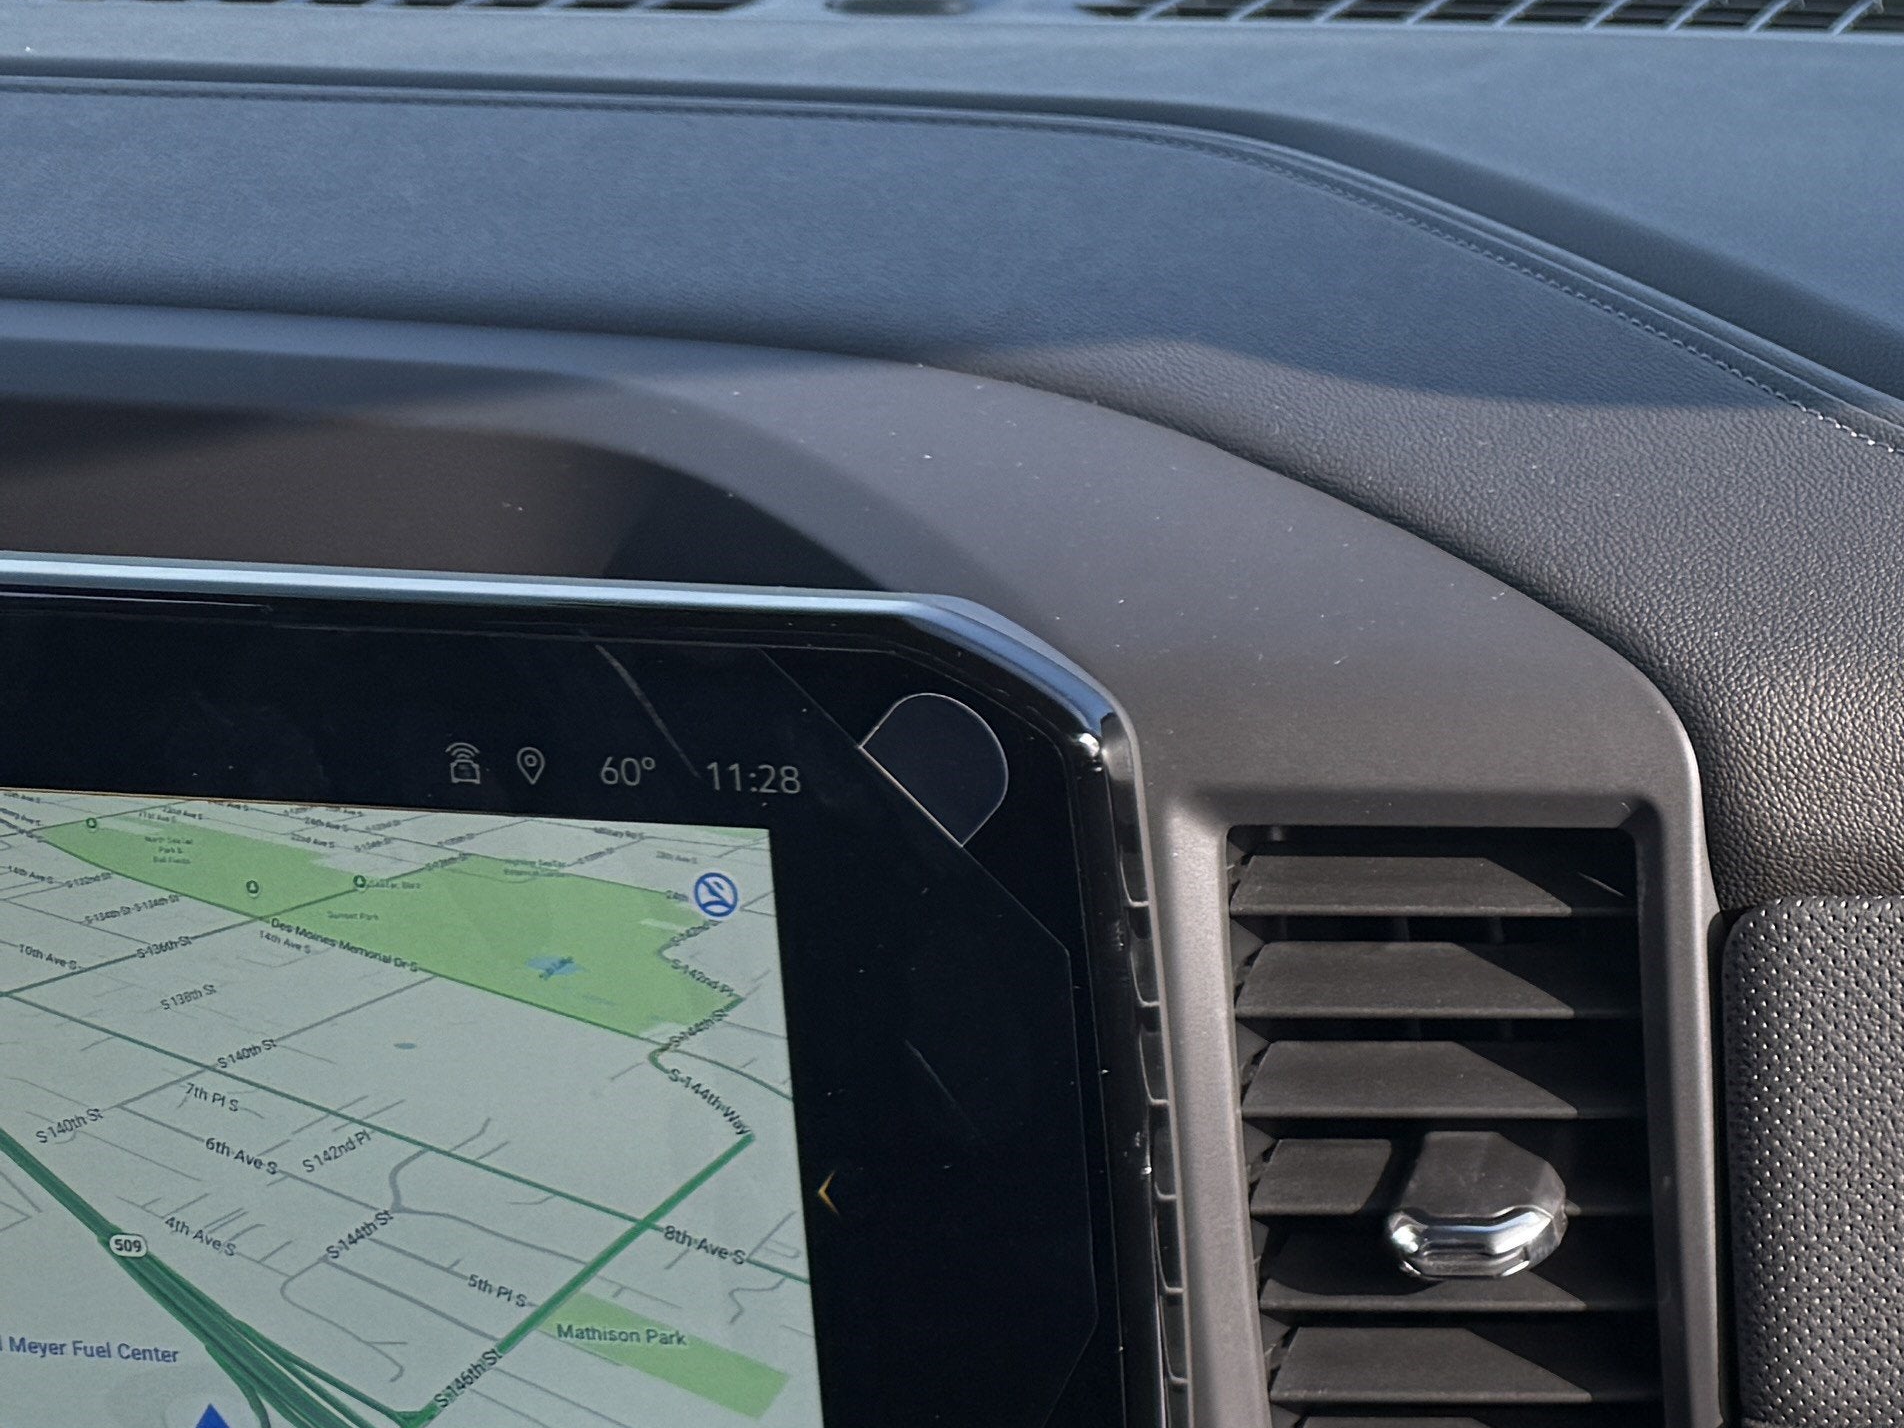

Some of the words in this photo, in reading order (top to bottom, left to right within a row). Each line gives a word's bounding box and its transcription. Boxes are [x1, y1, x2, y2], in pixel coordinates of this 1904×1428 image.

[707, 762, 800, 794] 11:28
[271, 918, 293, 933] Des
[295, 925, 337, 947] Moines
[339, 940, 392, 964] Memorial
[283, 938, 303, 951] Ave
[46, 952, 67, 967] Ave
[160, 999, 170, 1011] S
[203, 983, 217, 995] St
[217, 1057, 228, 1070] S
[228, 1044, 262, 1065] 140th
[262, 1038, 277, 1051] St
[185, 1082, 208, 1102] 7th
[212, 1092, 226, 1108] Pl
[229, 1099, 239, 1113] S
[669, 1068, 681, 1083] S
[682, 1076, 723, 1110] 144th
[722, 1105, 751, 1136] Way
[36, 1130, 48, 1144] S
[48, 1114, 87, 1139] 140th
[87, 1107, 103, 1122] St
[205, 1137, 230, 1159] 6th
[233, 1148, 265, 1169] Ave
[266, 1161, 278, 1175] S
[302, 1158, 315, 1174] S
[314, 1138, 357, 1166] 142nd
[355, 1129, 371, 1147] Pl
[114, 1238, 143, 1253] 509
[165, 1215, 190, 1237] 4th
[192, 1228, 224, 1251] Ave
[224, 1241, 236, 1257] S
[326, 1245, 339, 1260] S
[338, 1221, 378, 1252] 144th
[375, 1209, 394, 1228] St
[663, 1224, 693, 1249] 8th
[696, 1238, 728, 1261] Ave
[732, 1248, 746, 1266] S
[467, 1274, 493, 1295] 5th
[496, 1285, 513, 1302] Pl
[515, 1294, 527, 1308] S
[8, 1335, 68, 1358] Meyer
[72, 1340, 112, 1359] Fuel
[117, 1342, 181, 1363] Center
[556, 1323, 641, 1343] Mathison
[646, 1328, 687, 1346] Park
[434, 1392, 449, 1409] S
[446, 1363, 486, 1400] 146th
[482, 1348, 503, 1368] St
